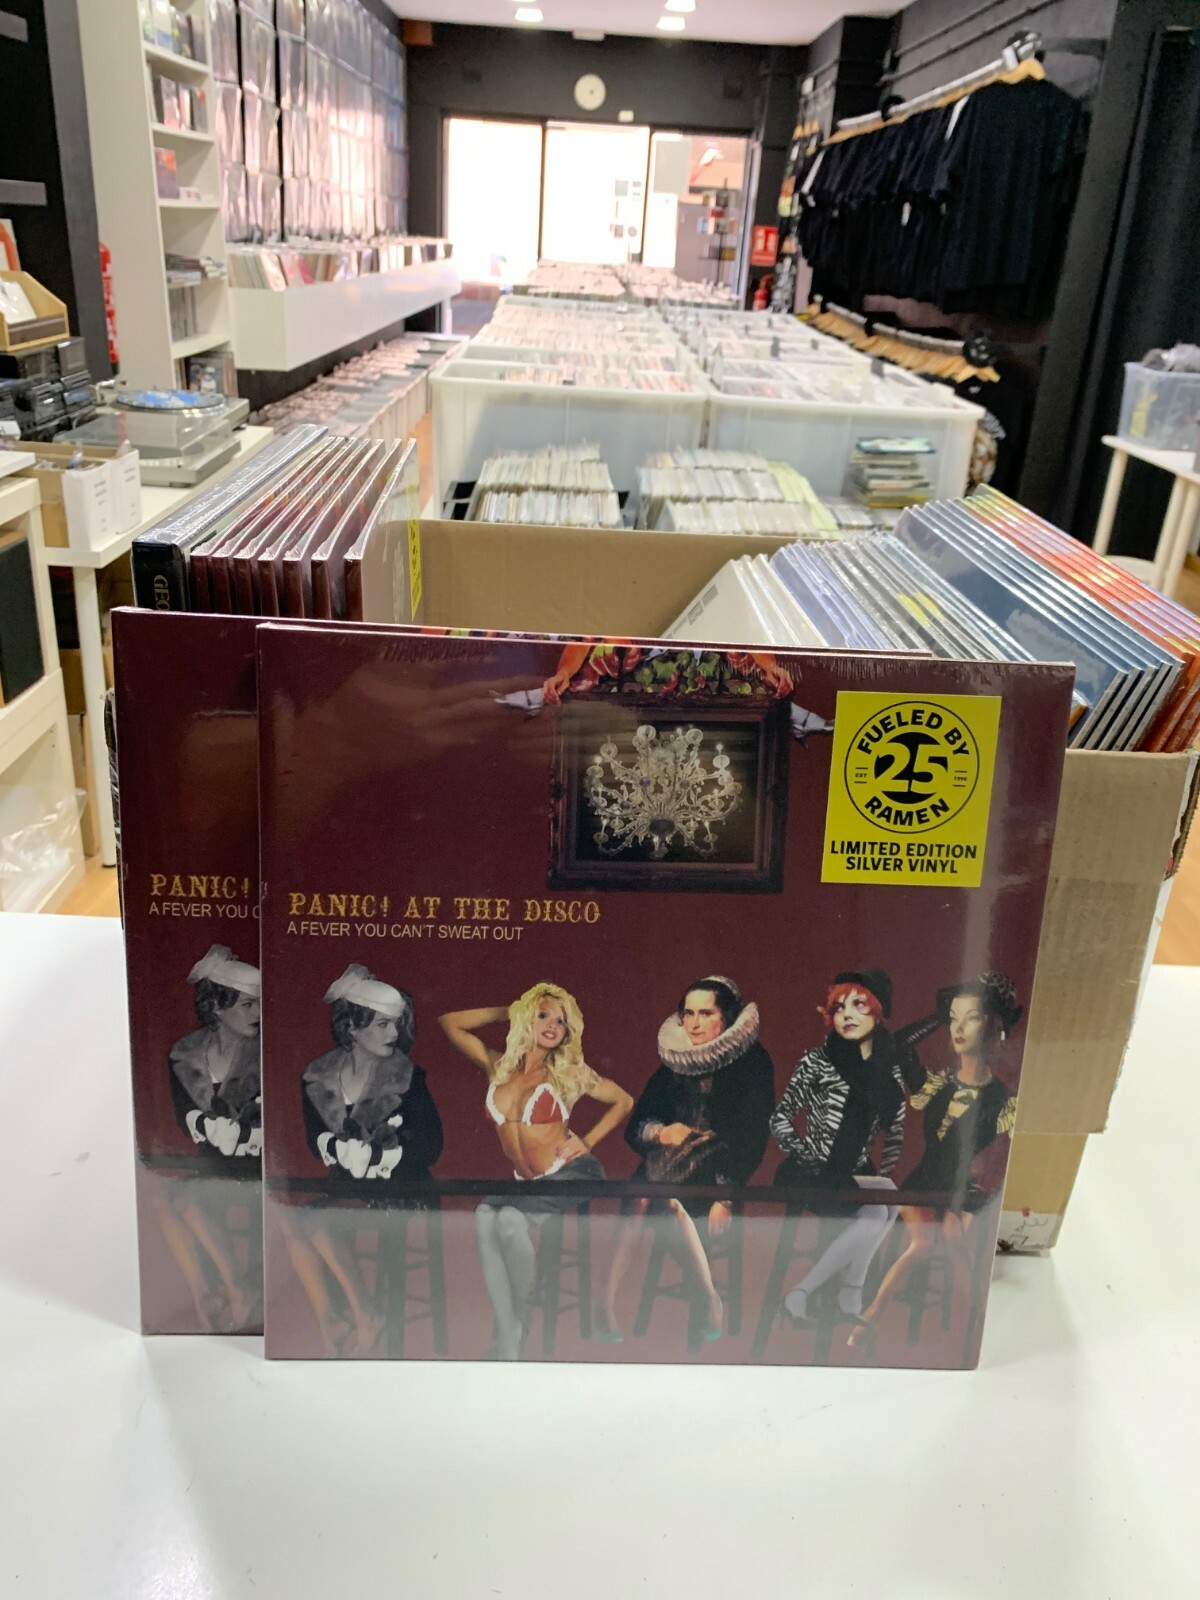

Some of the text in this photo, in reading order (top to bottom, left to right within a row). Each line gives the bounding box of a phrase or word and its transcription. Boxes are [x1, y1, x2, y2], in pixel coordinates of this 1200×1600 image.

[857, 709, 970, 756] FUELED BY
[873, 742, 949, 795] 25
[864, 795, 950, 826] RAMEN
[830, 840, 977, 859] LIMITED EDITION
[846, 857, 958, 873] SILVER VINYL
[150, 873, 249, 899] PANIC!
[149, 902, 159, 915] A
[162, 902, 211, 917] FEVER
[216, 904, 248, 918] YOU
[288, 892, 601, 923] PANIC! AT THE DISCO
[287, 921, 524, 941] A FEVER YOU CAN'T SWEAT OUT
